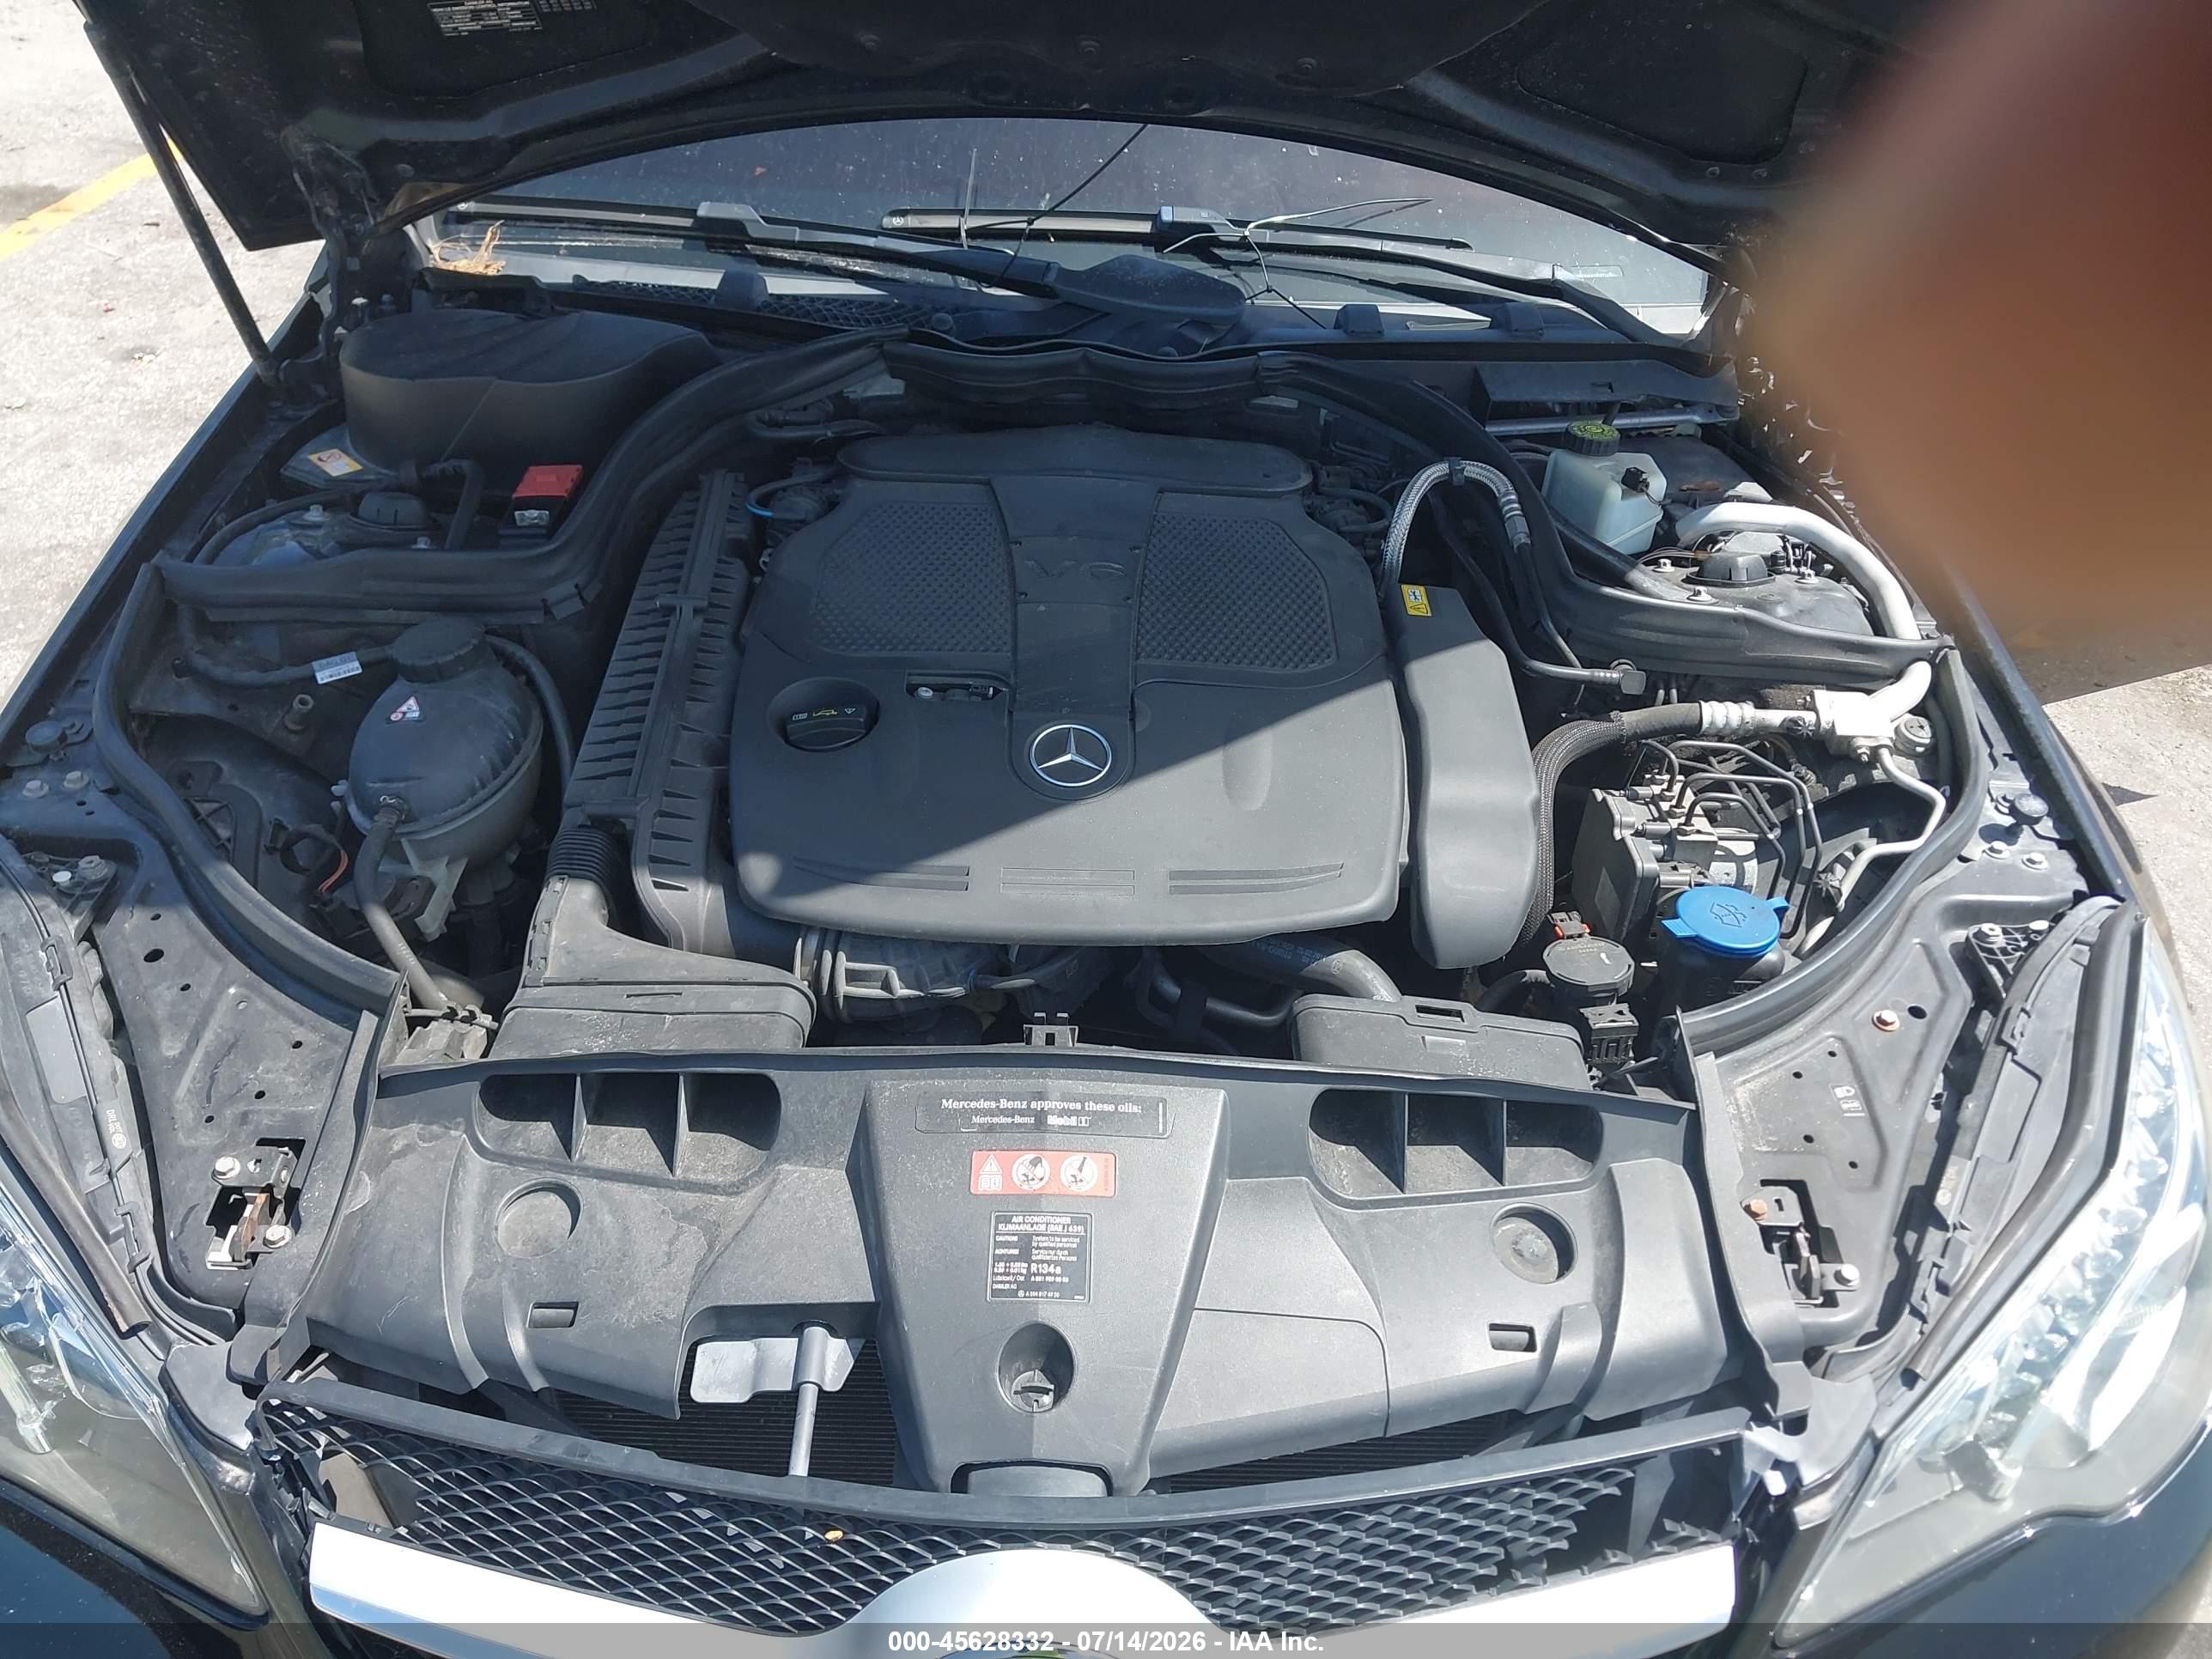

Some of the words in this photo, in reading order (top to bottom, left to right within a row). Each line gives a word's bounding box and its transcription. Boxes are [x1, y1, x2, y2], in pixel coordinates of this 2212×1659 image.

[940, 1098, 1028, 1109] Mercedes-Benz
[1030, 1100, 1082, 1111] approves
[1085, 1101, 1115, 1112] these
[1117, 1103, 1142, 1113] oils:
[971, 1115, 1035, 1124] Mercedes-Benz
[1024, 1216, 1072, 1224] CONDITIONER
